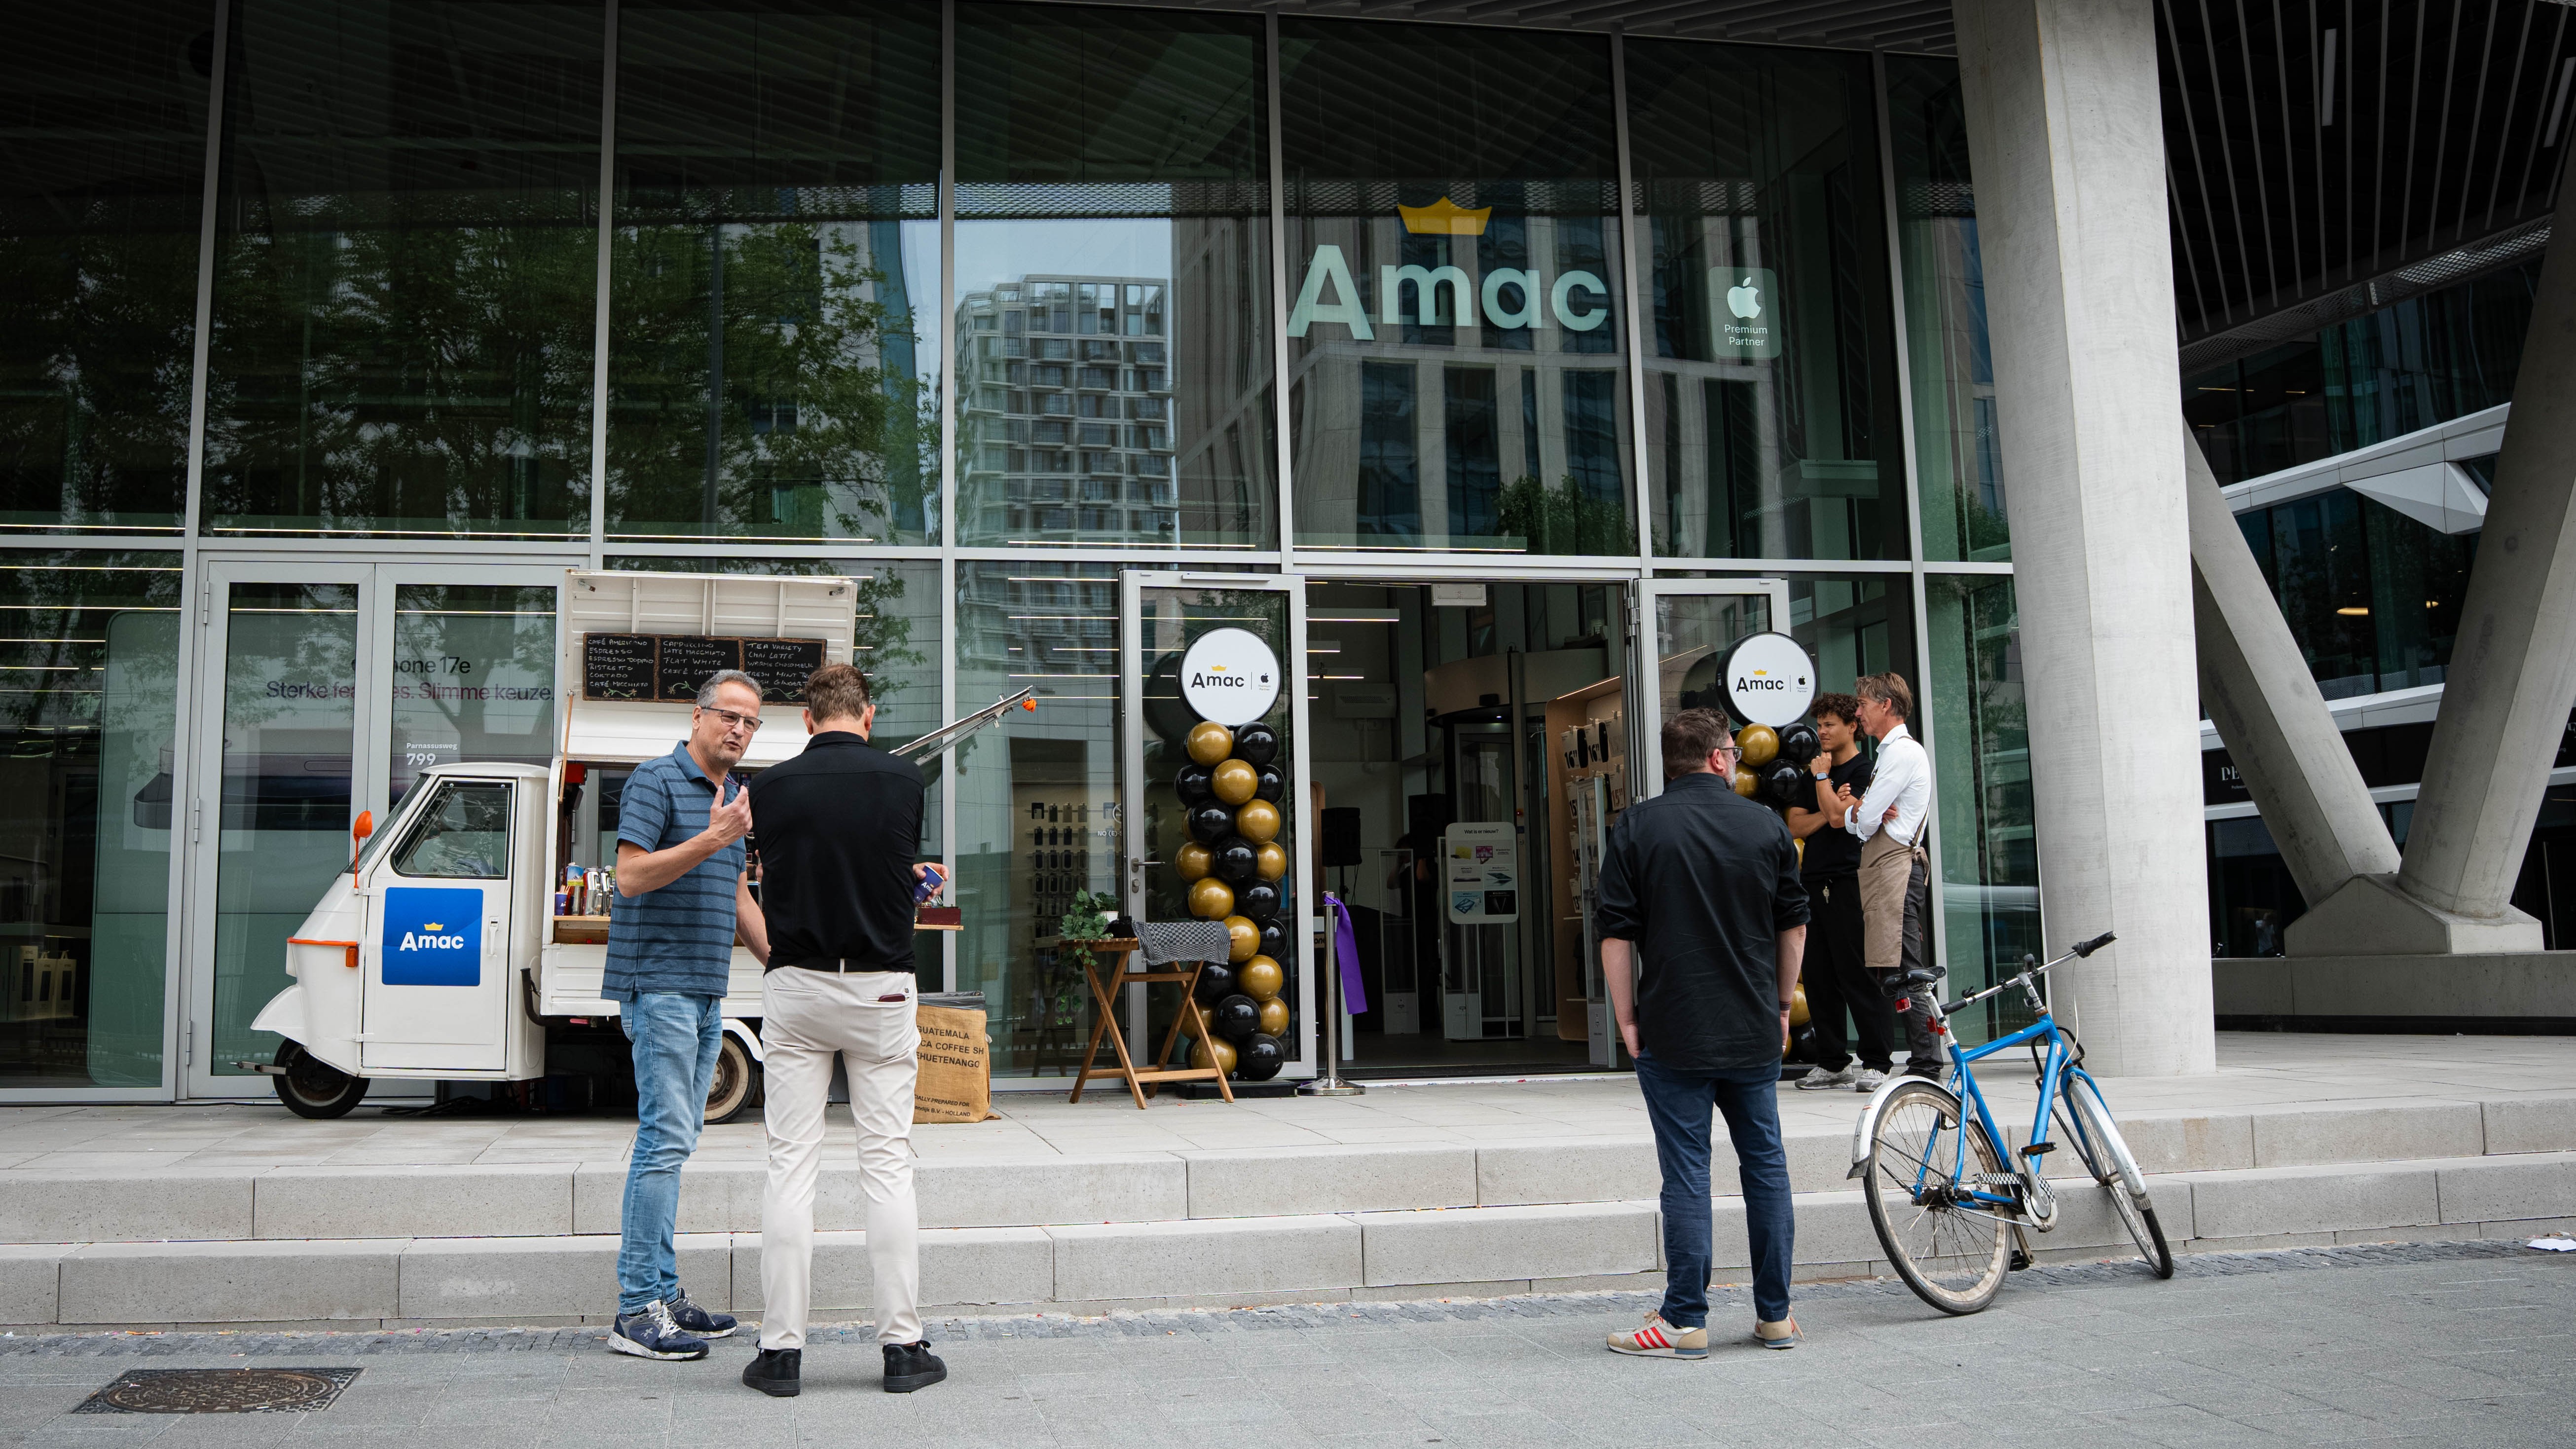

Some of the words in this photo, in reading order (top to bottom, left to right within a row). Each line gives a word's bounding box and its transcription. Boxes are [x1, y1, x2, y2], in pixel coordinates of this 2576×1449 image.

[1286, 244, 1608, 340] Amac
[1725, 324, 1767, 334] Premium
[1729, 336, 1765, 346] Partner
[773, 644, 802, 652] VARIETY
[439, 657, 471, 674] 17e
[1191, 672, 1245, 688] Amac
[1736, 677, 1784, 692] Amac
[266, 680, 328, 699] Sterke
[419, 682, 490, 700] Slimme
[406, 753, 436, 765] 799
[921, 882, 933, 892] Ama
[399, 931, 464, 952] Amac
[917, 1025, 970, 1040] GUATEMALA
[935, 1042, 970, 1054] COFFEE
[916, 1052, 980, 1068] EHUETENANGO
